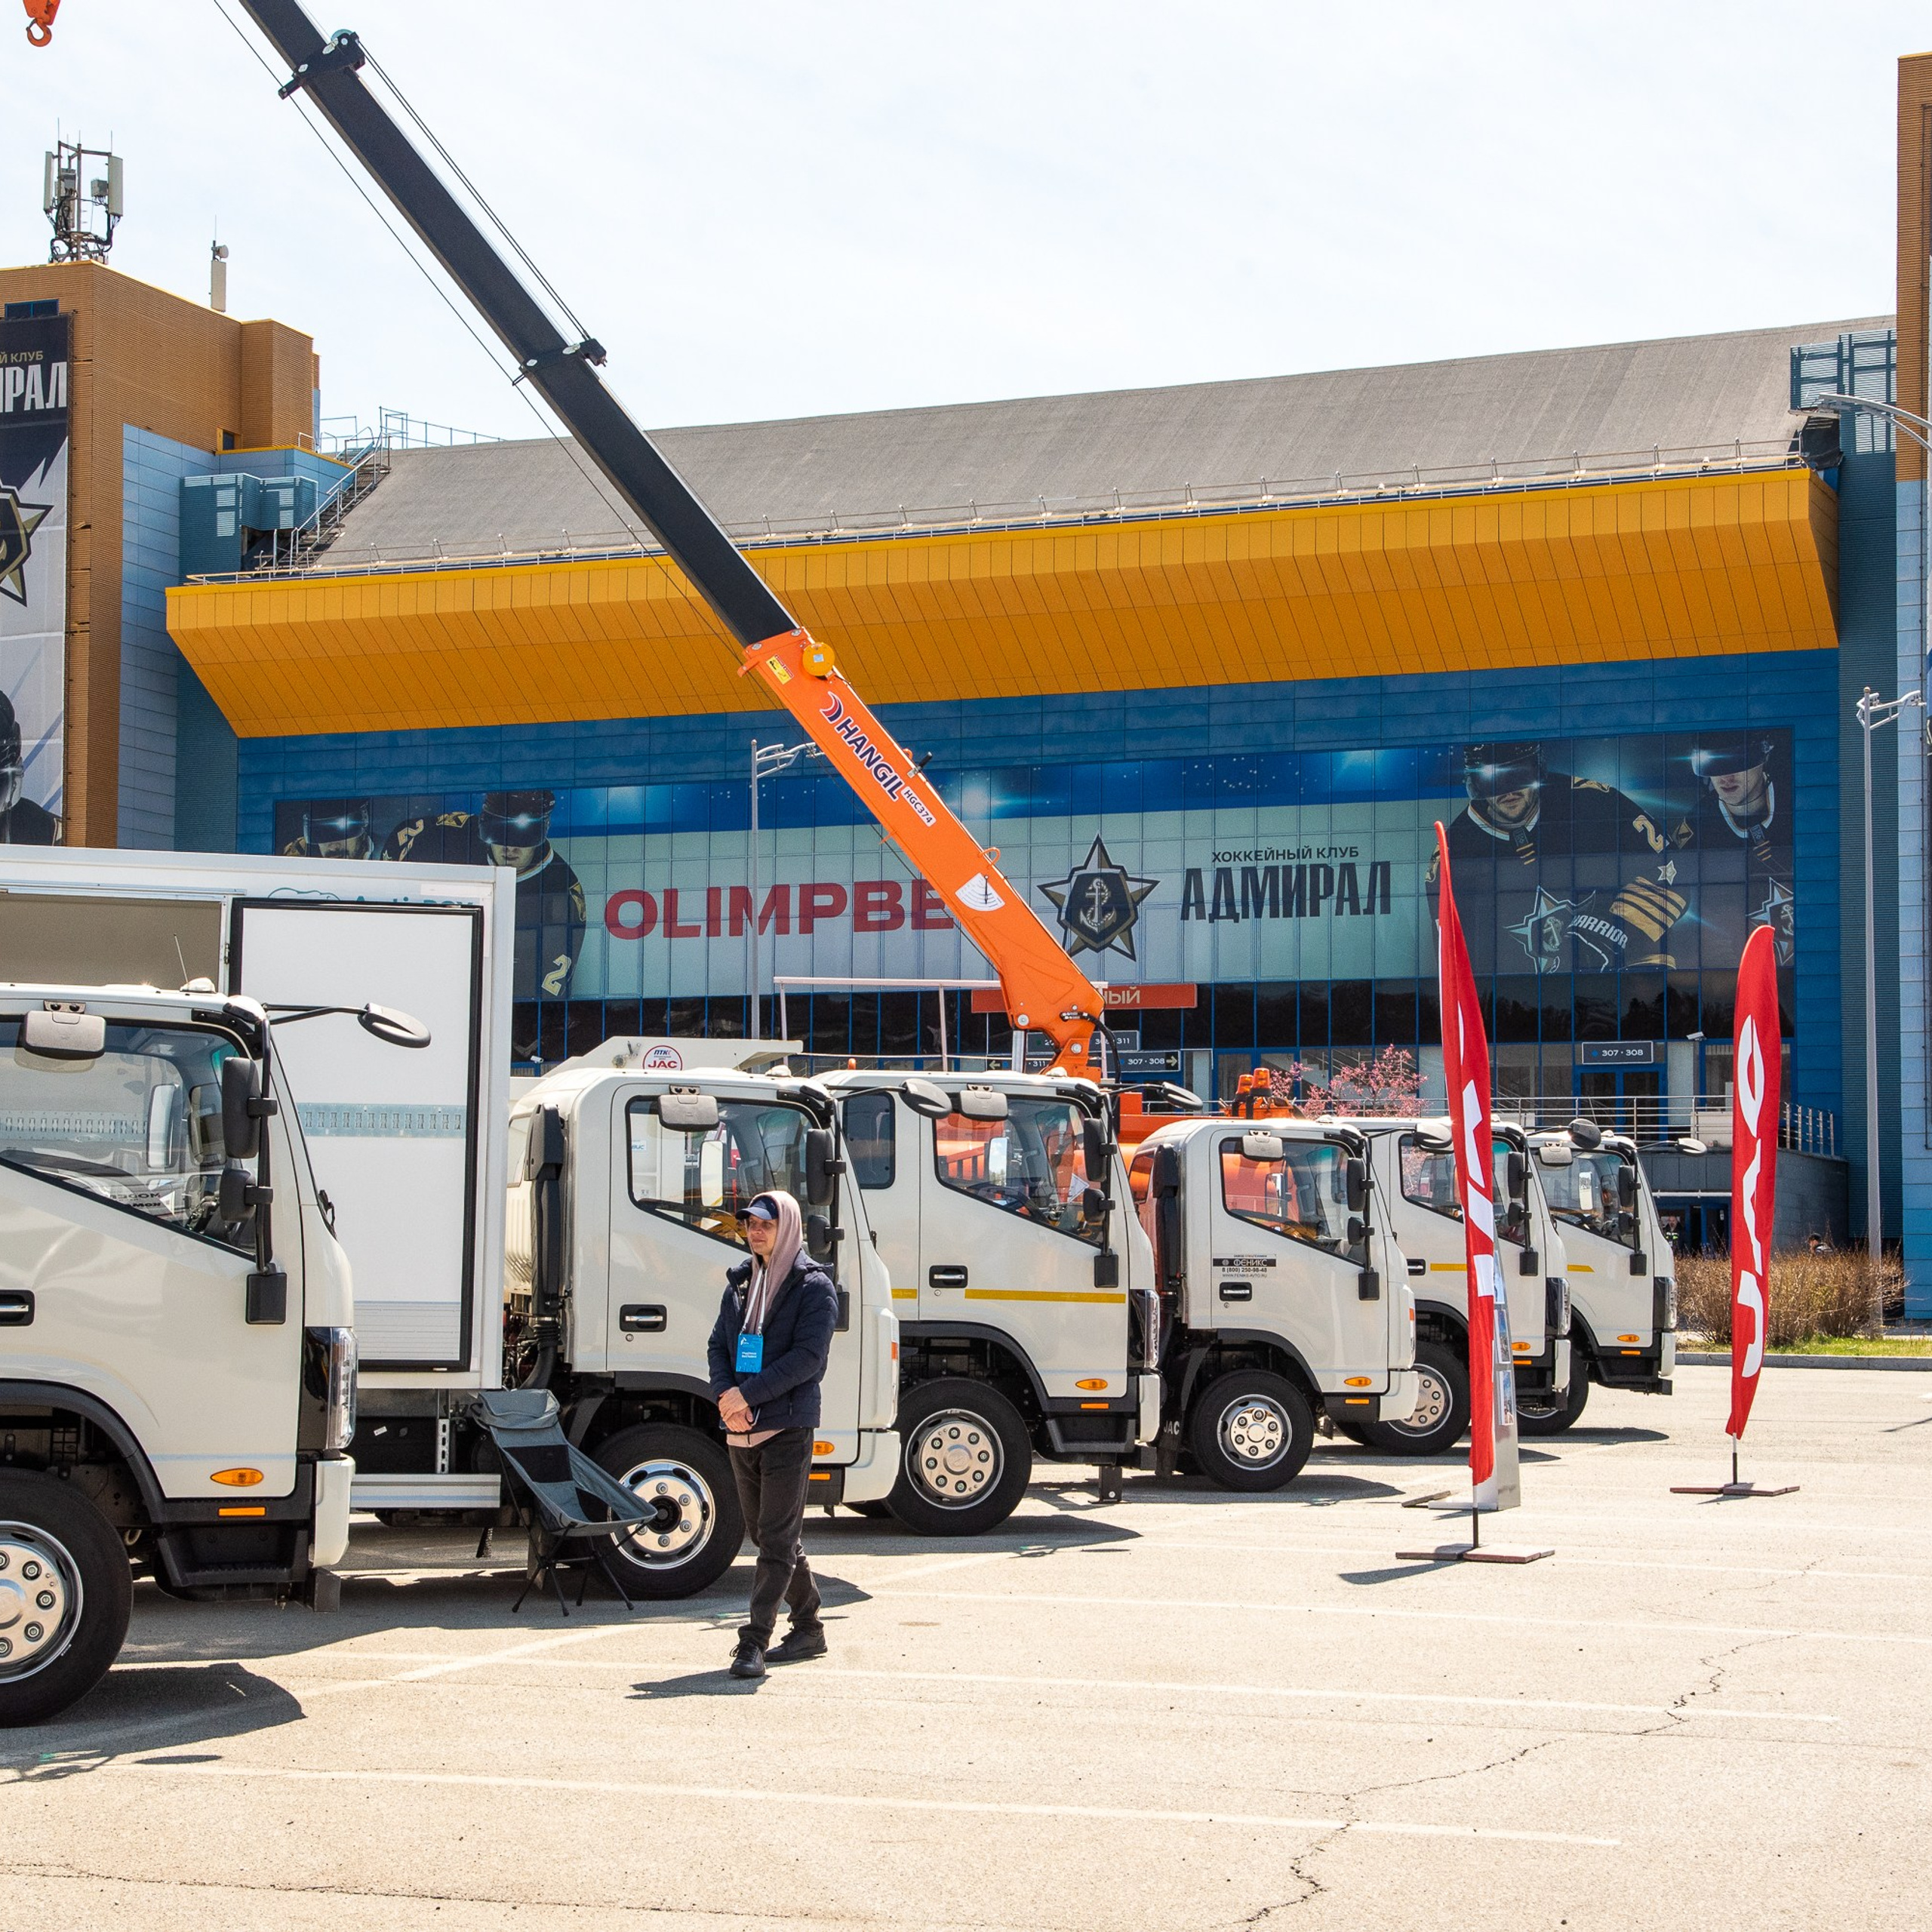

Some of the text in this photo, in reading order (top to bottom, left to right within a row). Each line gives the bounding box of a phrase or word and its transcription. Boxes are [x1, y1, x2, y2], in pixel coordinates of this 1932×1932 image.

[11, 351, 44, 363] КЛУБ
[0, 361, 67, 413] РАЛ
[835, 717, 934, 824] HANGIL HGC374
[1212, 845, 1359, 863] ХОККЕЙНЫЙ КЛУБ
[1180, 861, 1392, 924] АДМИРАЛ
[648, 1060, 678, 1069] JAC
[1233, 1258, 1268, 1266] ФЕНИКС
[1163, 1420, 1180, 1435] JAC
